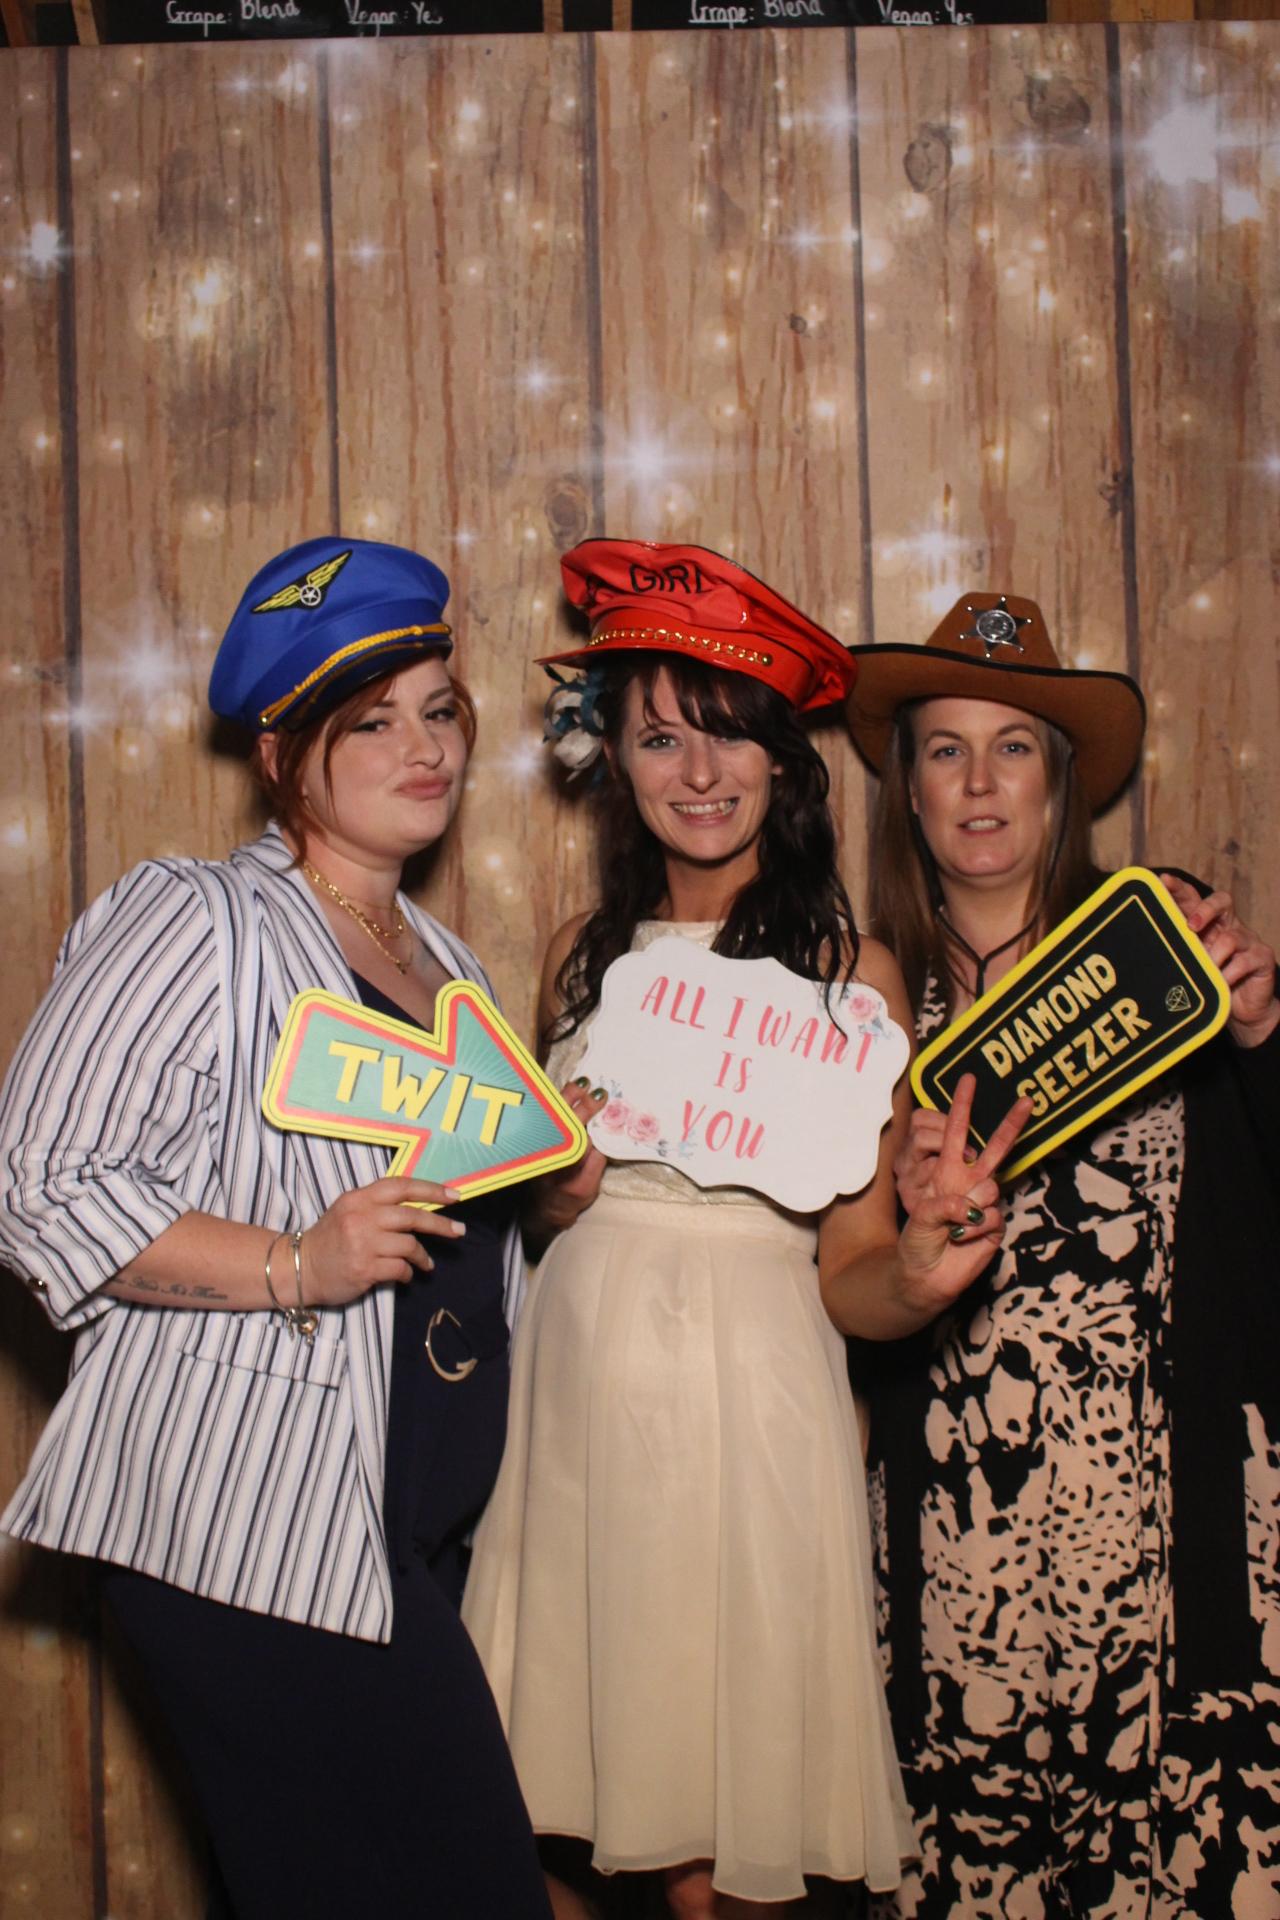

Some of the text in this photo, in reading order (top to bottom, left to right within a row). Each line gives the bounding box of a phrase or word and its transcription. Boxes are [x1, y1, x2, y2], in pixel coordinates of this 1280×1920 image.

[241, 0, 300, 19] Blend
[629, 563, 713, 594] GIRL
[640, 976, 878, 1073] ALL I WANT
[981, 953, 1117, 1079] DIAMOND
[328, 1039, 524, 1147] TWIT
[713, 1051, 752, 1093] IS
[1016, 997, 1152, 1117] GEEZER
[681, 1100, 764, 1160] YOU
